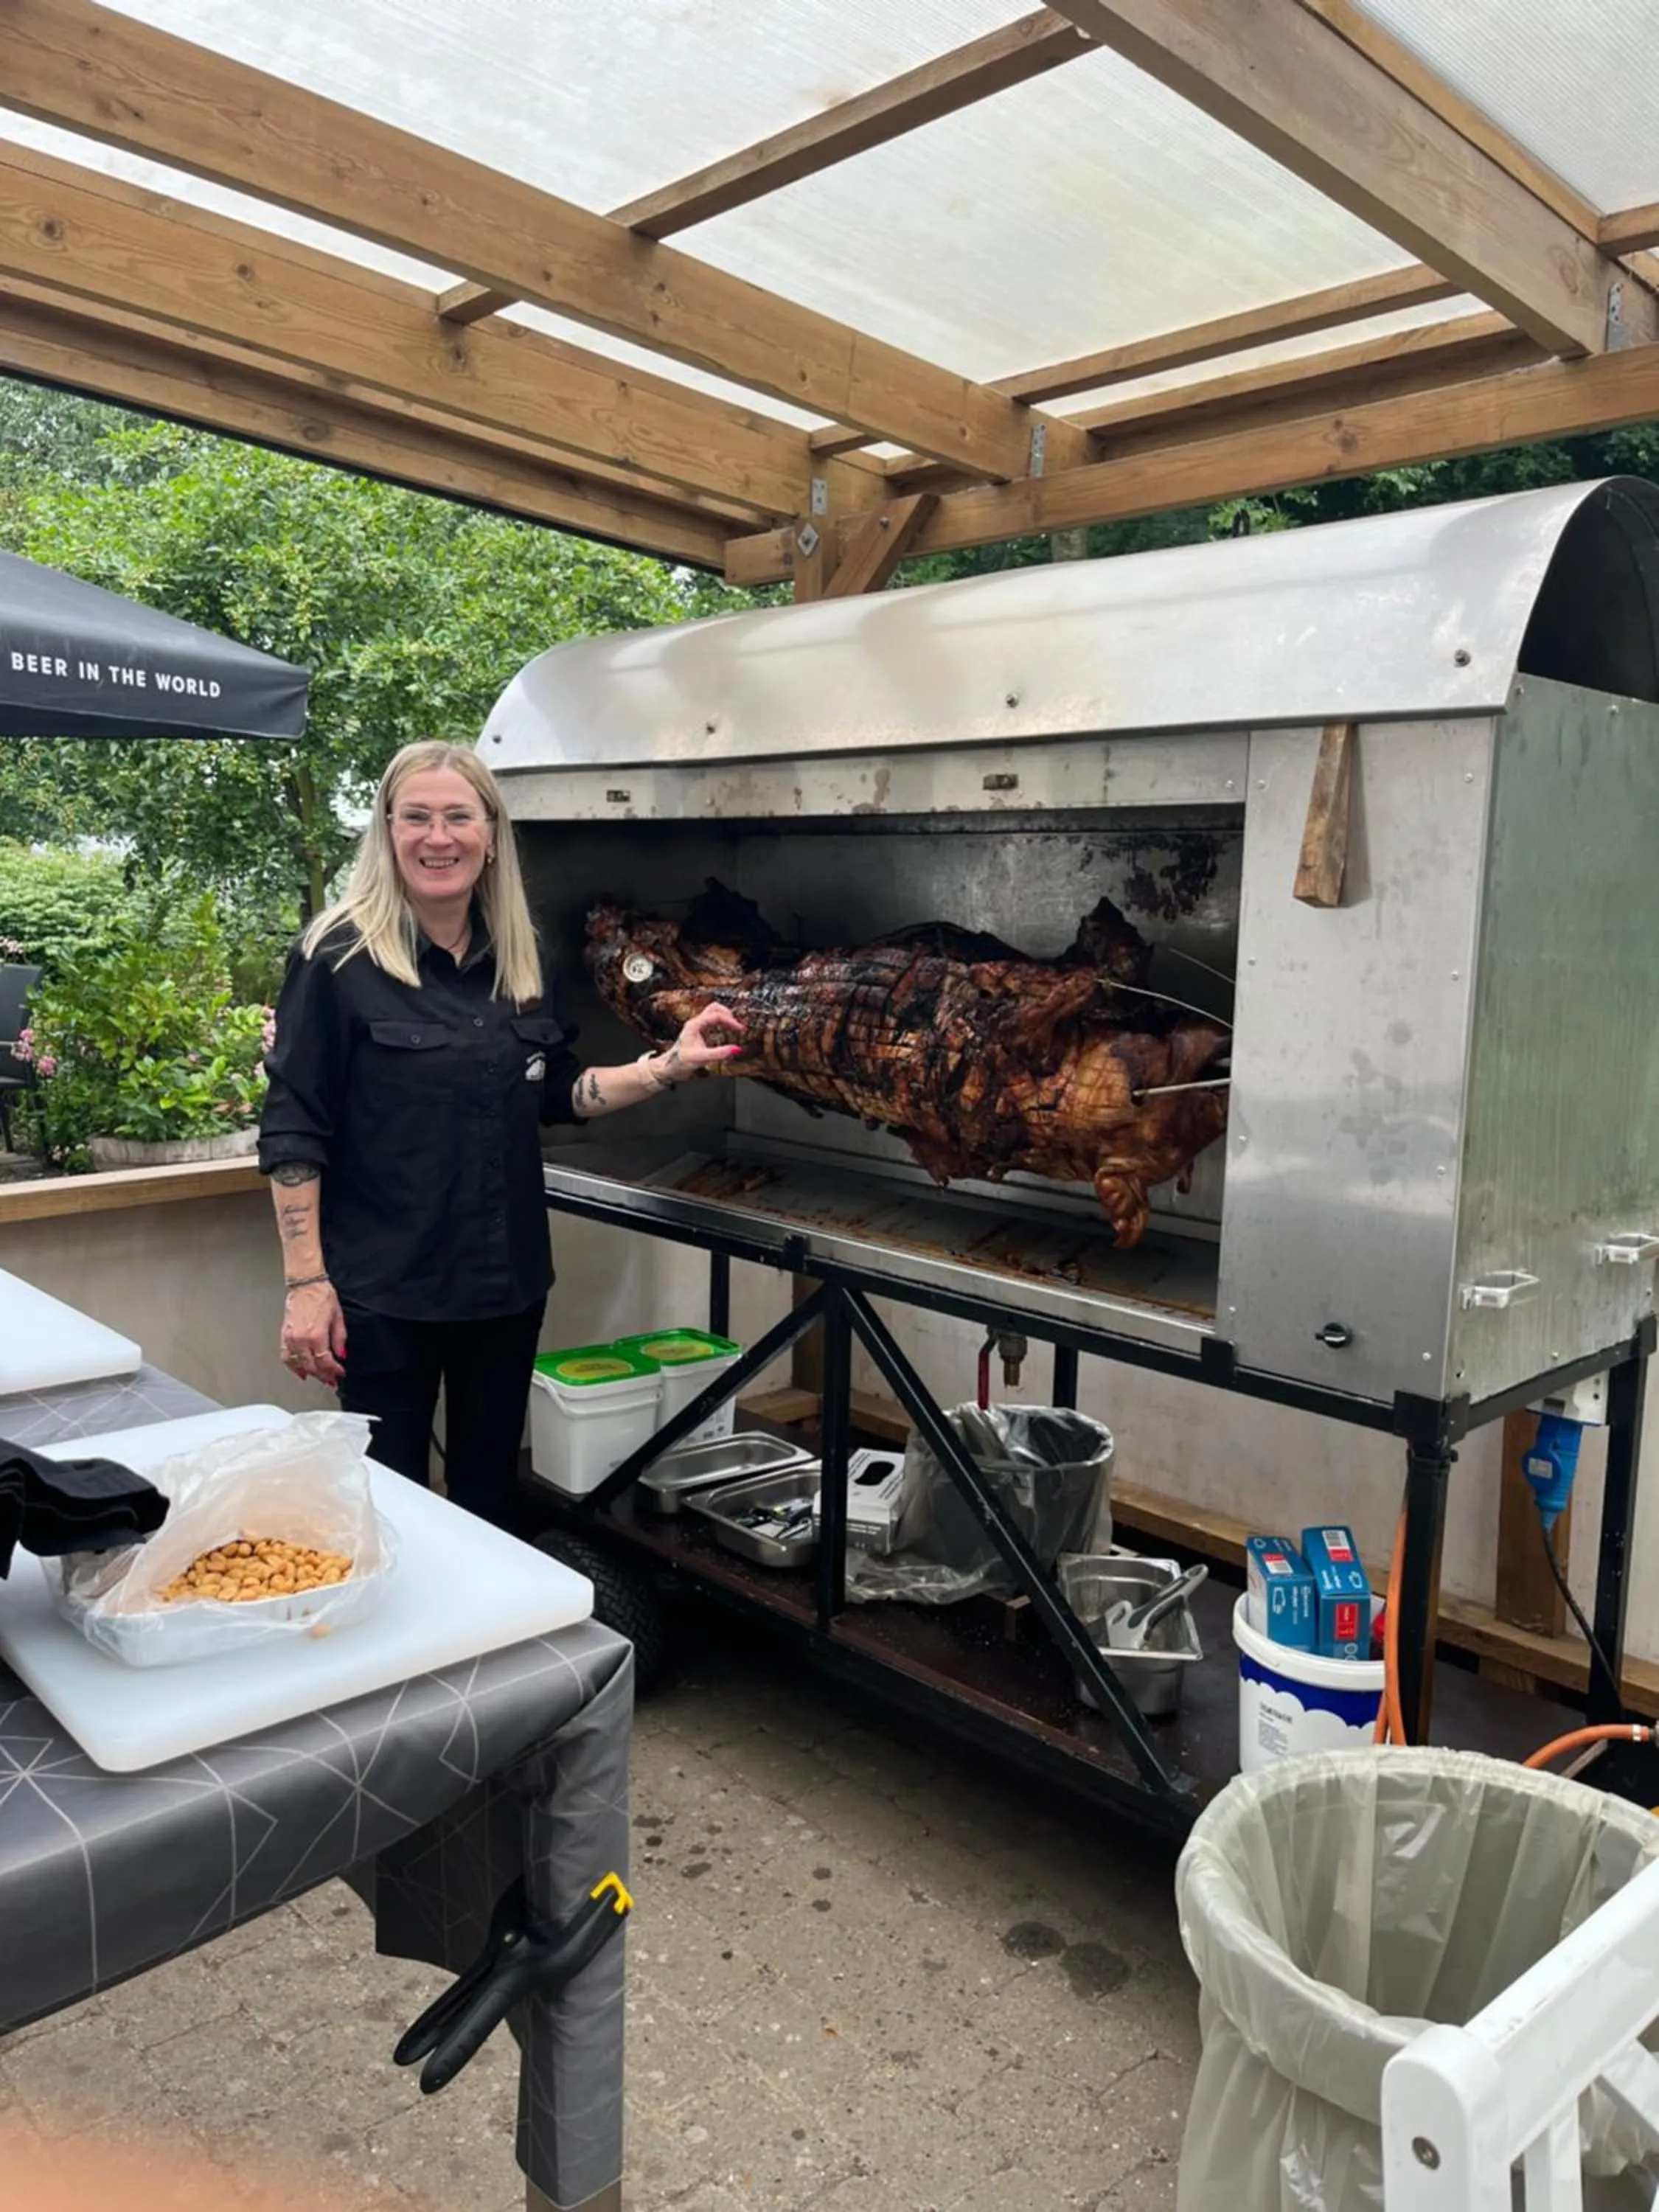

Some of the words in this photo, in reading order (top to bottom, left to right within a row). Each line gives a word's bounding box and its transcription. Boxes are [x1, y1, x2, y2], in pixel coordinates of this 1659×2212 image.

[11, 652, 67, 677] BEER
[78, 661, 100, 681] IN
[108, 666, 147, 687] THE
[155, 672, 220, 698] WORLD
